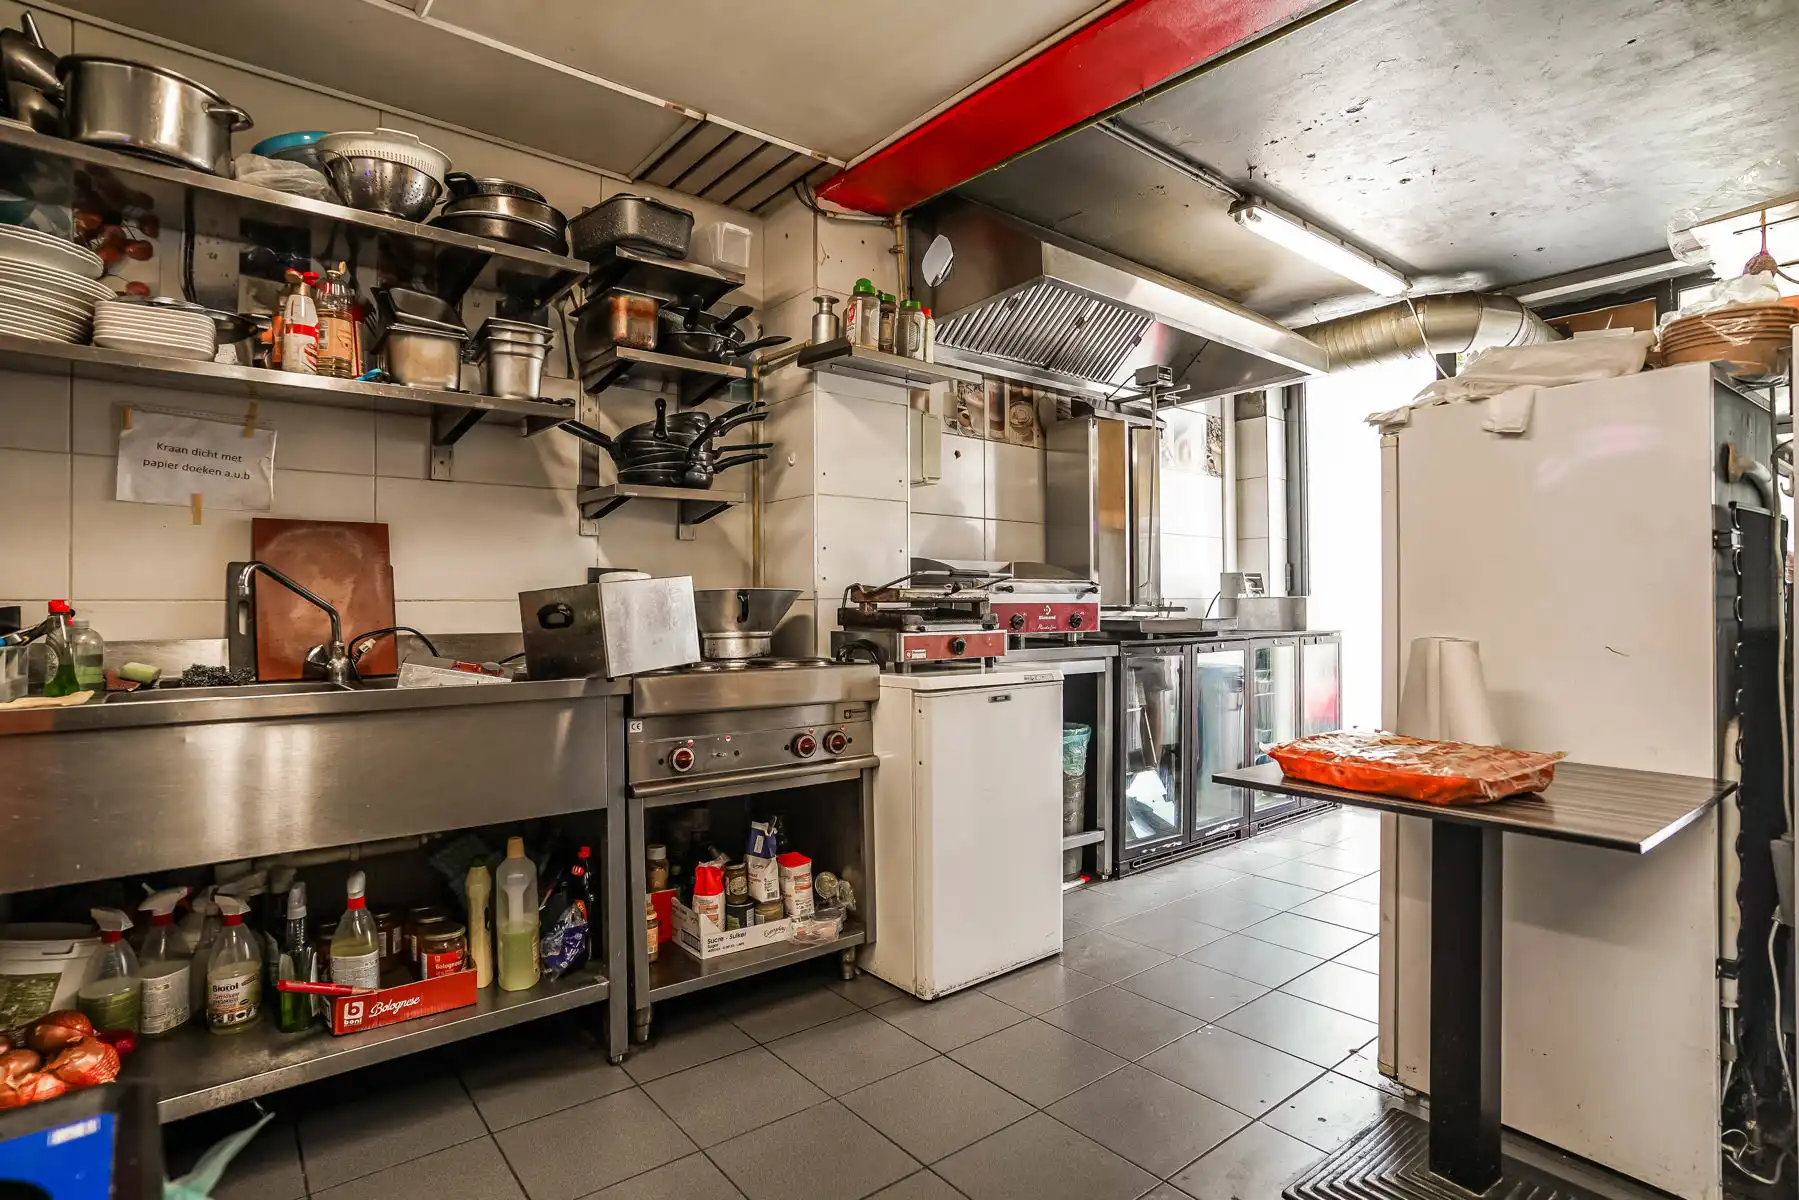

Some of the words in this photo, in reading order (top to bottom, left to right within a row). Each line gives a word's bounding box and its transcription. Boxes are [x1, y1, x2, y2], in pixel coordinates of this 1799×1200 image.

[156, 442, 188, 455] Kraan
[191, 447, 218, 459] dicht
[221, 453, 243, 463] met
[142, 458, 179, 470] papier
[182, 463, 222, 476] doeken
[224, 469, 250, 480] a.u.b
[631, 722, 641, 731] CE
[707, 936, 725, 945] Sucre
[368, 996, 421, 1018] Bolognese
